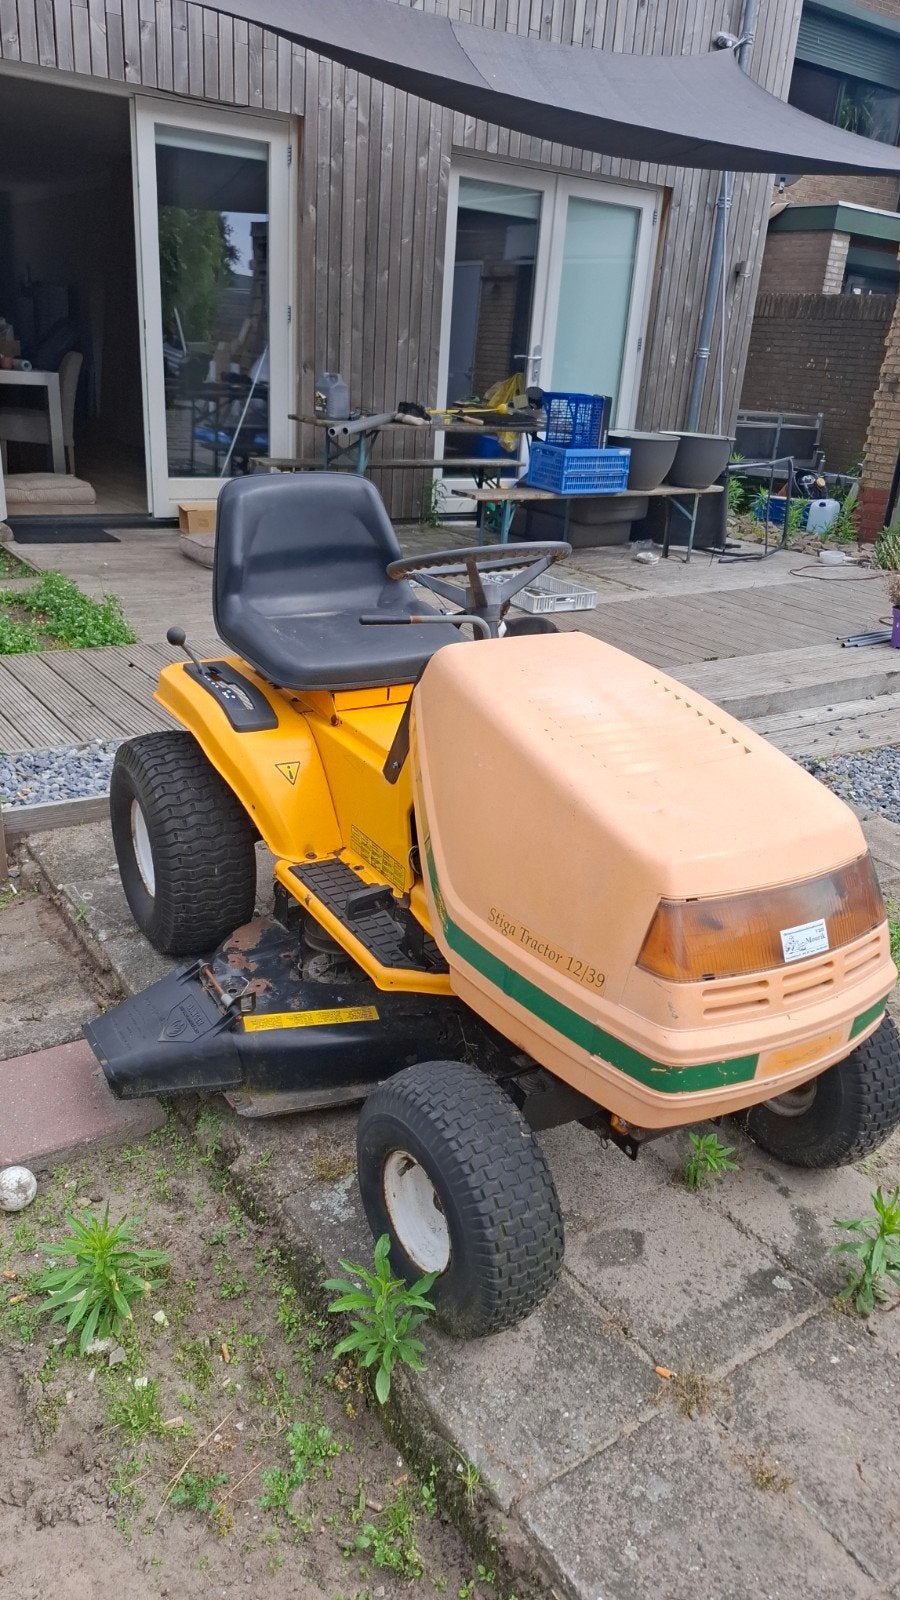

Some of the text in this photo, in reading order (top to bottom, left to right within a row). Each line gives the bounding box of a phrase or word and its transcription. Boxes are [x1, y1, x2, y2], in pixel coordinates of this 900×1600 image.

[488, 907, 606, 988] Stiga Tractor 12/39
